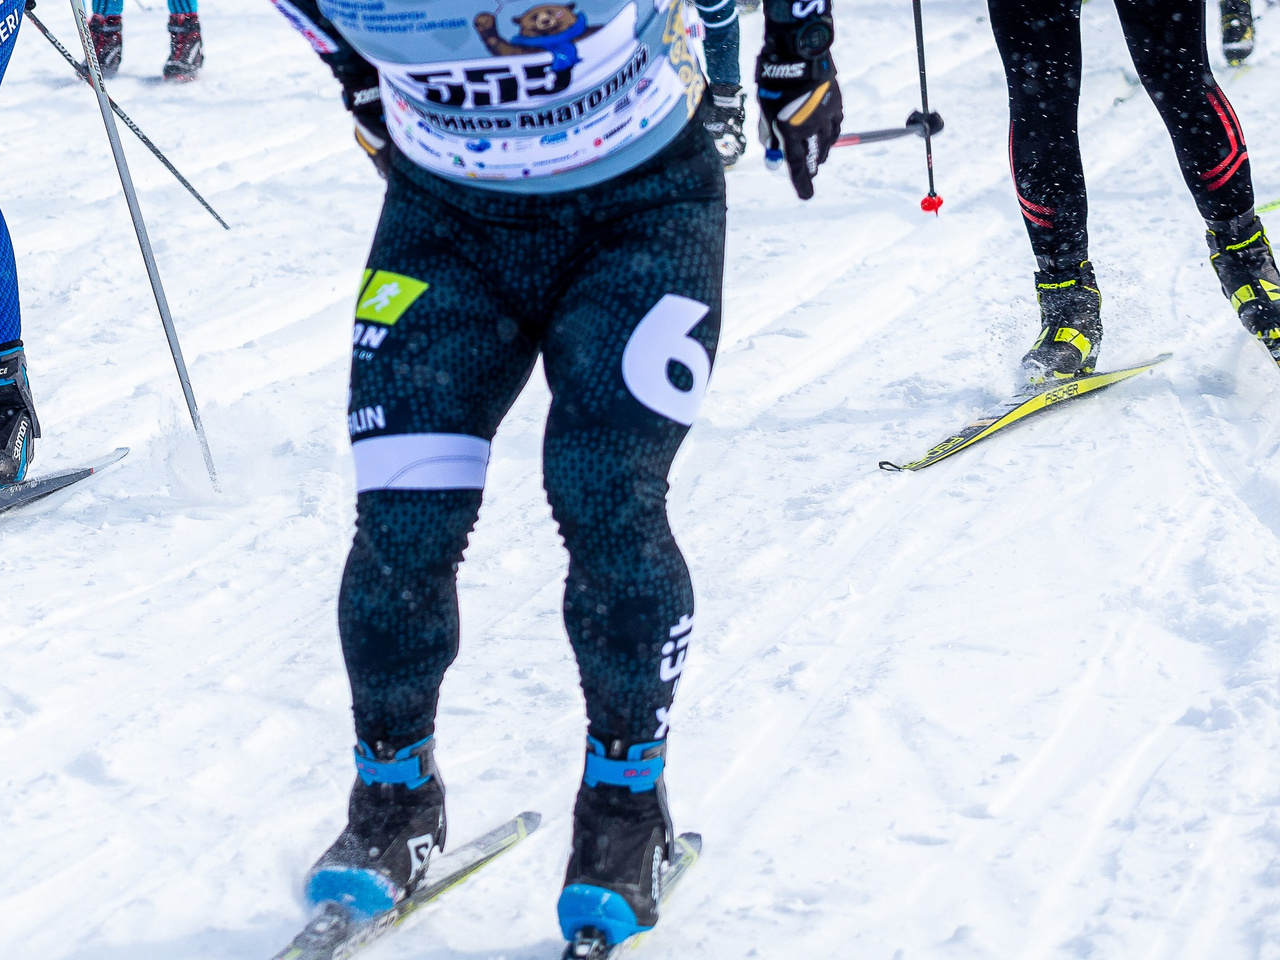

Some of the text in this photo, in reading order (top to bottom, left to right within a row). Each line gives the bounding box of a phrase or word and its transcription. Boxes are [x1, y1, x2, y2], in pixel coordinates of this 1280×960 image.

[1224, 230, 1263, 252] FISCHER
[1036, 279, 1077, 291] FISCHER
[1044, 383, 1080, 406] FISCHER
